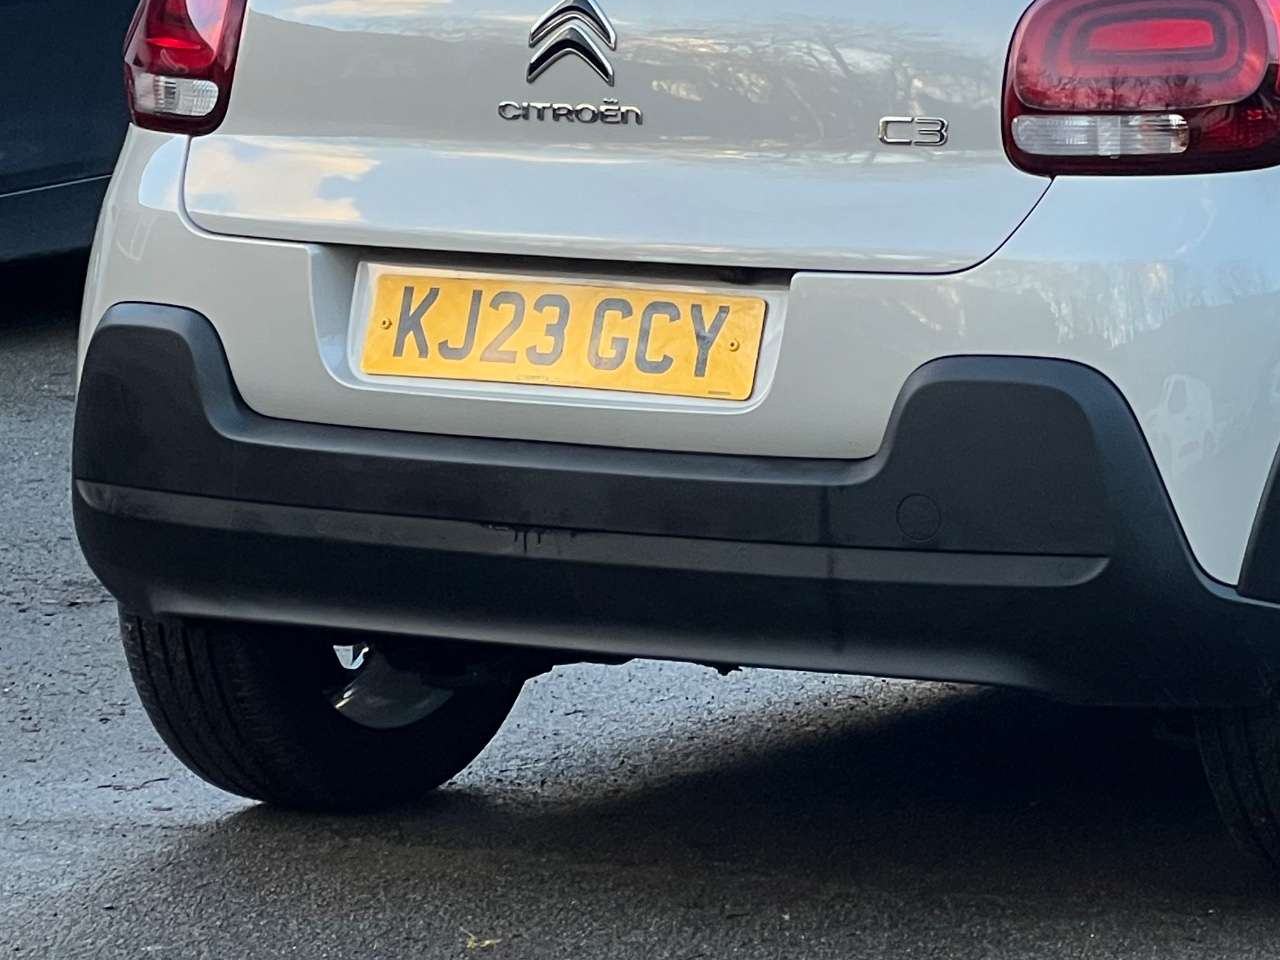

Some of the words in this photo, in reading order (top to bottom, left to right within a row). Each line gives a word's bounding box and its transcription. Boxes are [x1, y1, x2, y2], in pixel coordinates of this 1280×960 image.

[879, 116, 948, 146] C3
[393, 286, 570, 367] KJ23
[586, 297, 731, 378] GCY
